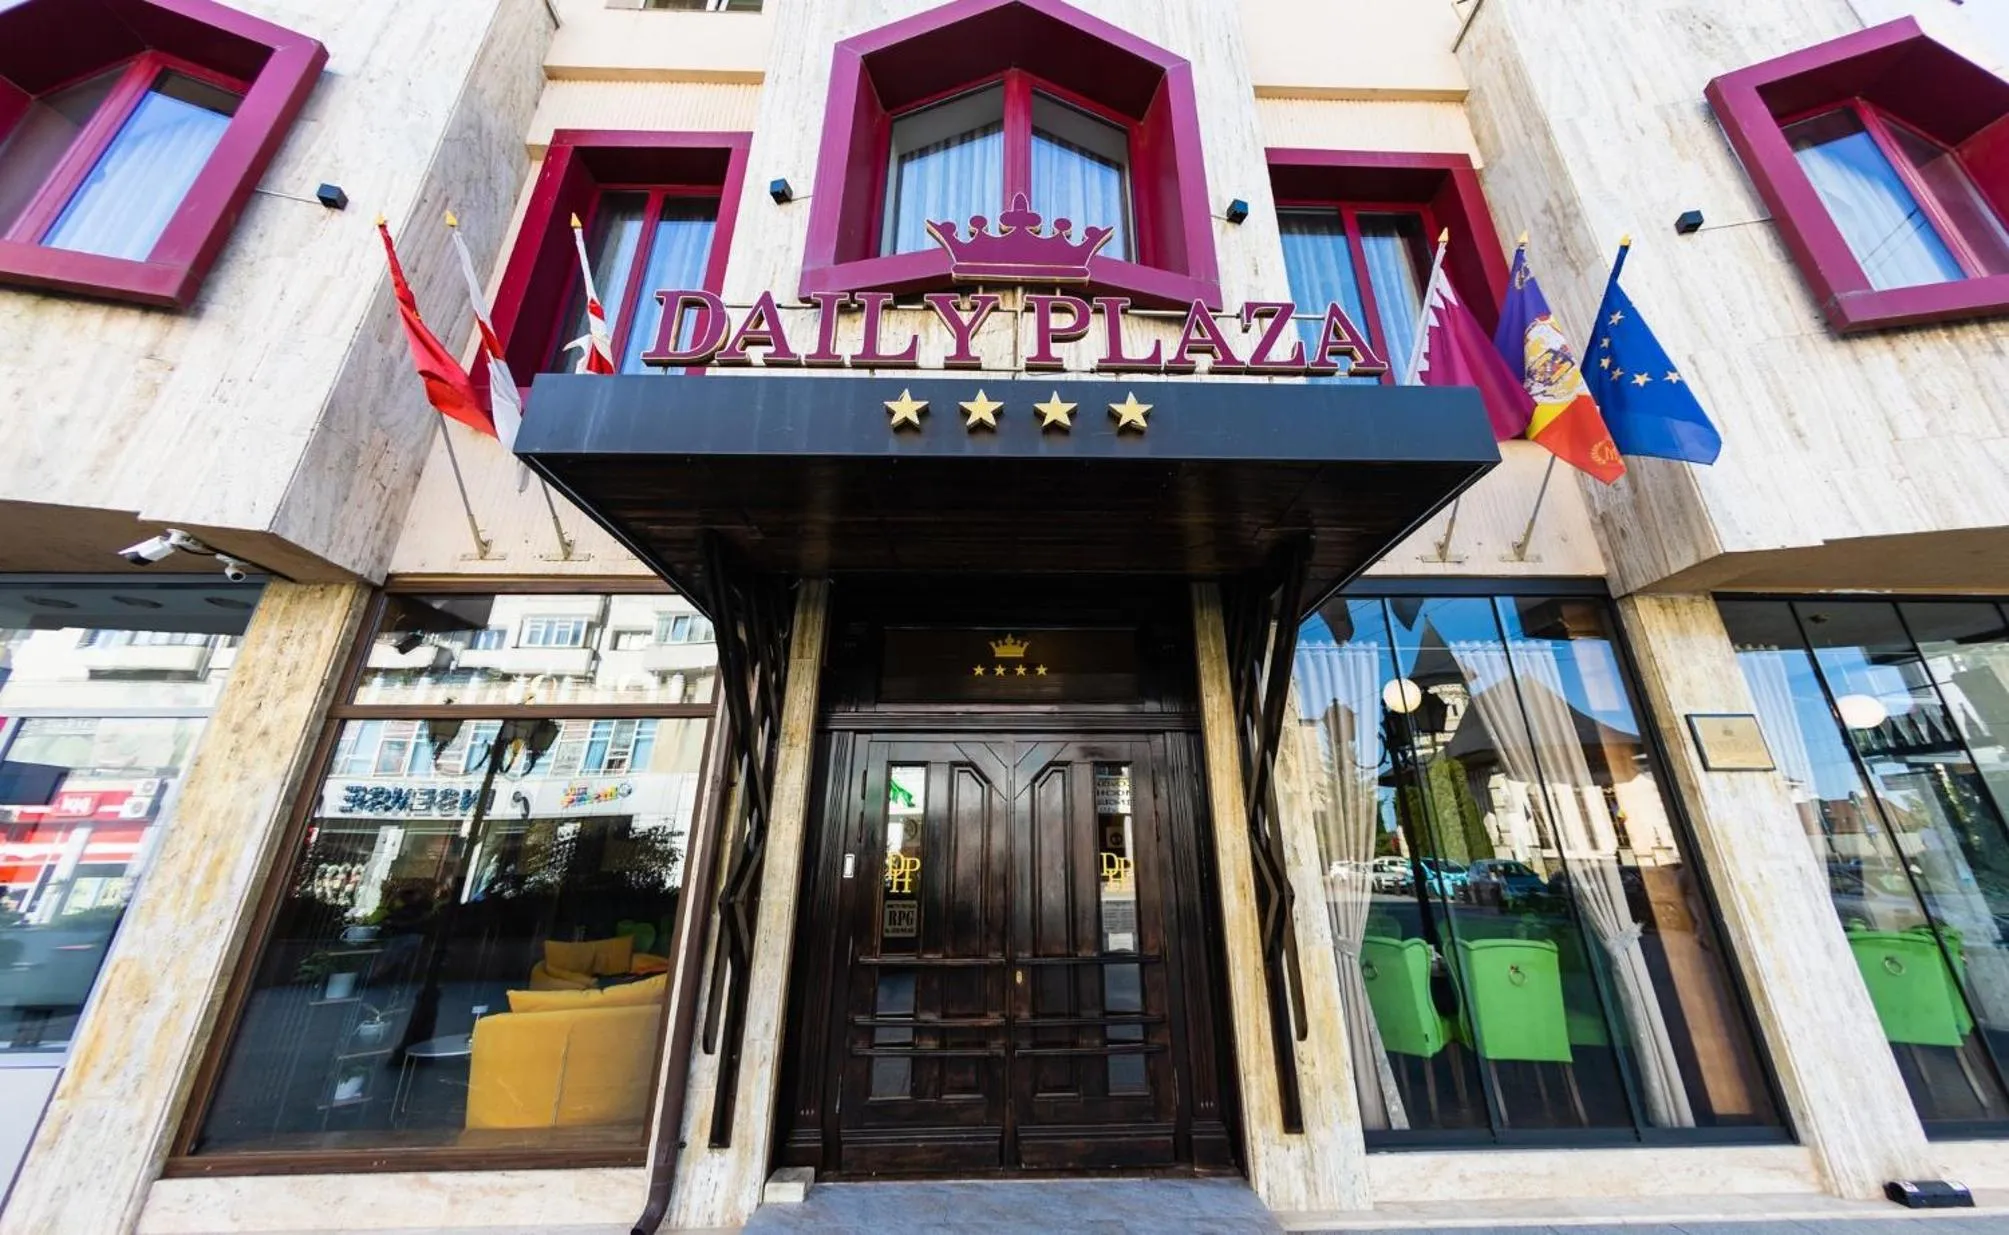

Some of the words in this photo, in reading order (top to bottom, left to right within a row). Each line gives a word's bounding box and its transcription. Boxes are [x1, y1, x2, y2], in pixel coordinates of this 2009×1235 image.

[641, 289, 999, 369] DAILY
[1023, 293, 1388, 376] PLAZA
[888, 910, 914, 926] RPG
